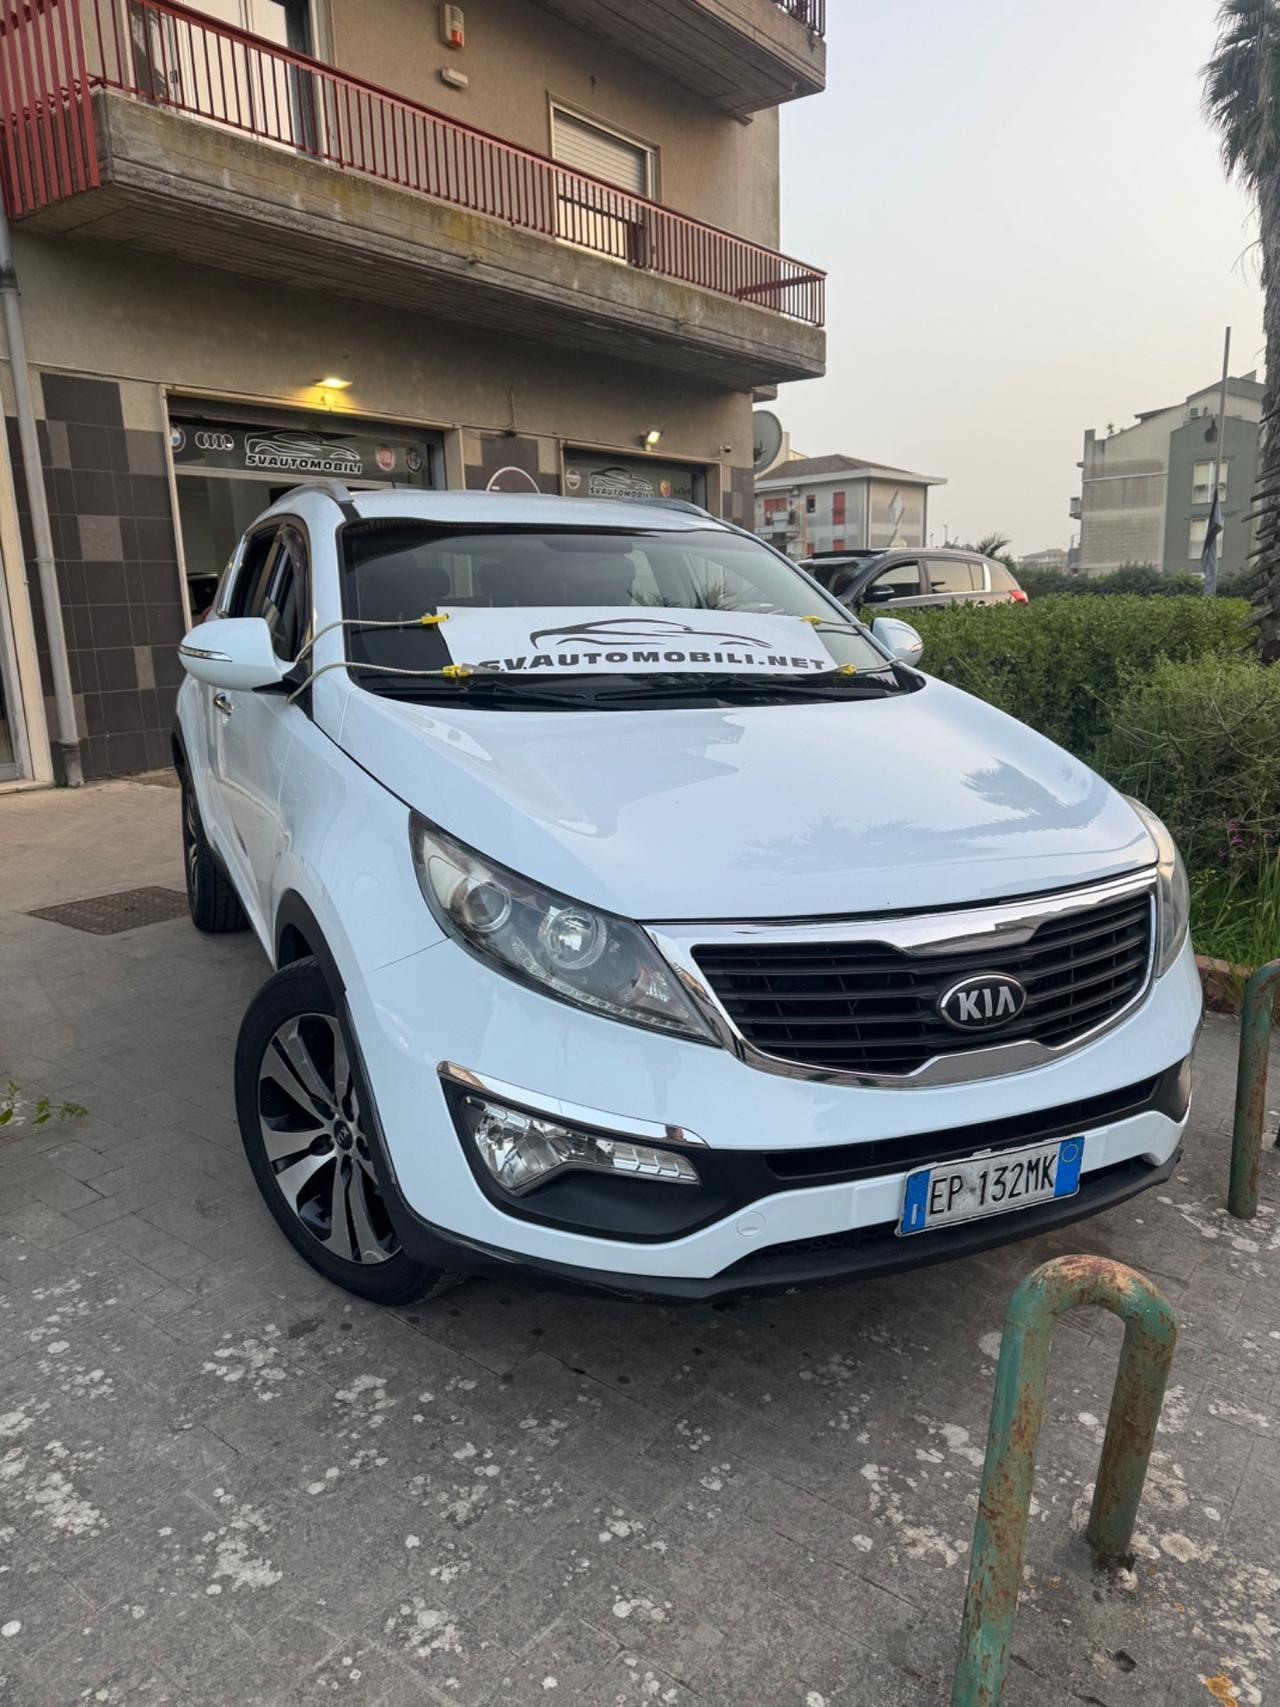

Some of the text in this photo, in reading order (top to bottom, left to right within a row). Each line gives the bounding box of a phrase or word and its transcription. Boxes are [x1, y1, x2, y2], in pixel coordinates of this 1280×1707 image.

[245, 454, 363, 475] SVAUTOMOBILI
[956, 986, 1016, 1021] KIA
[929, 1175, 964, 1215] EP
[979, 1154, 1058, 1206] 132MK
